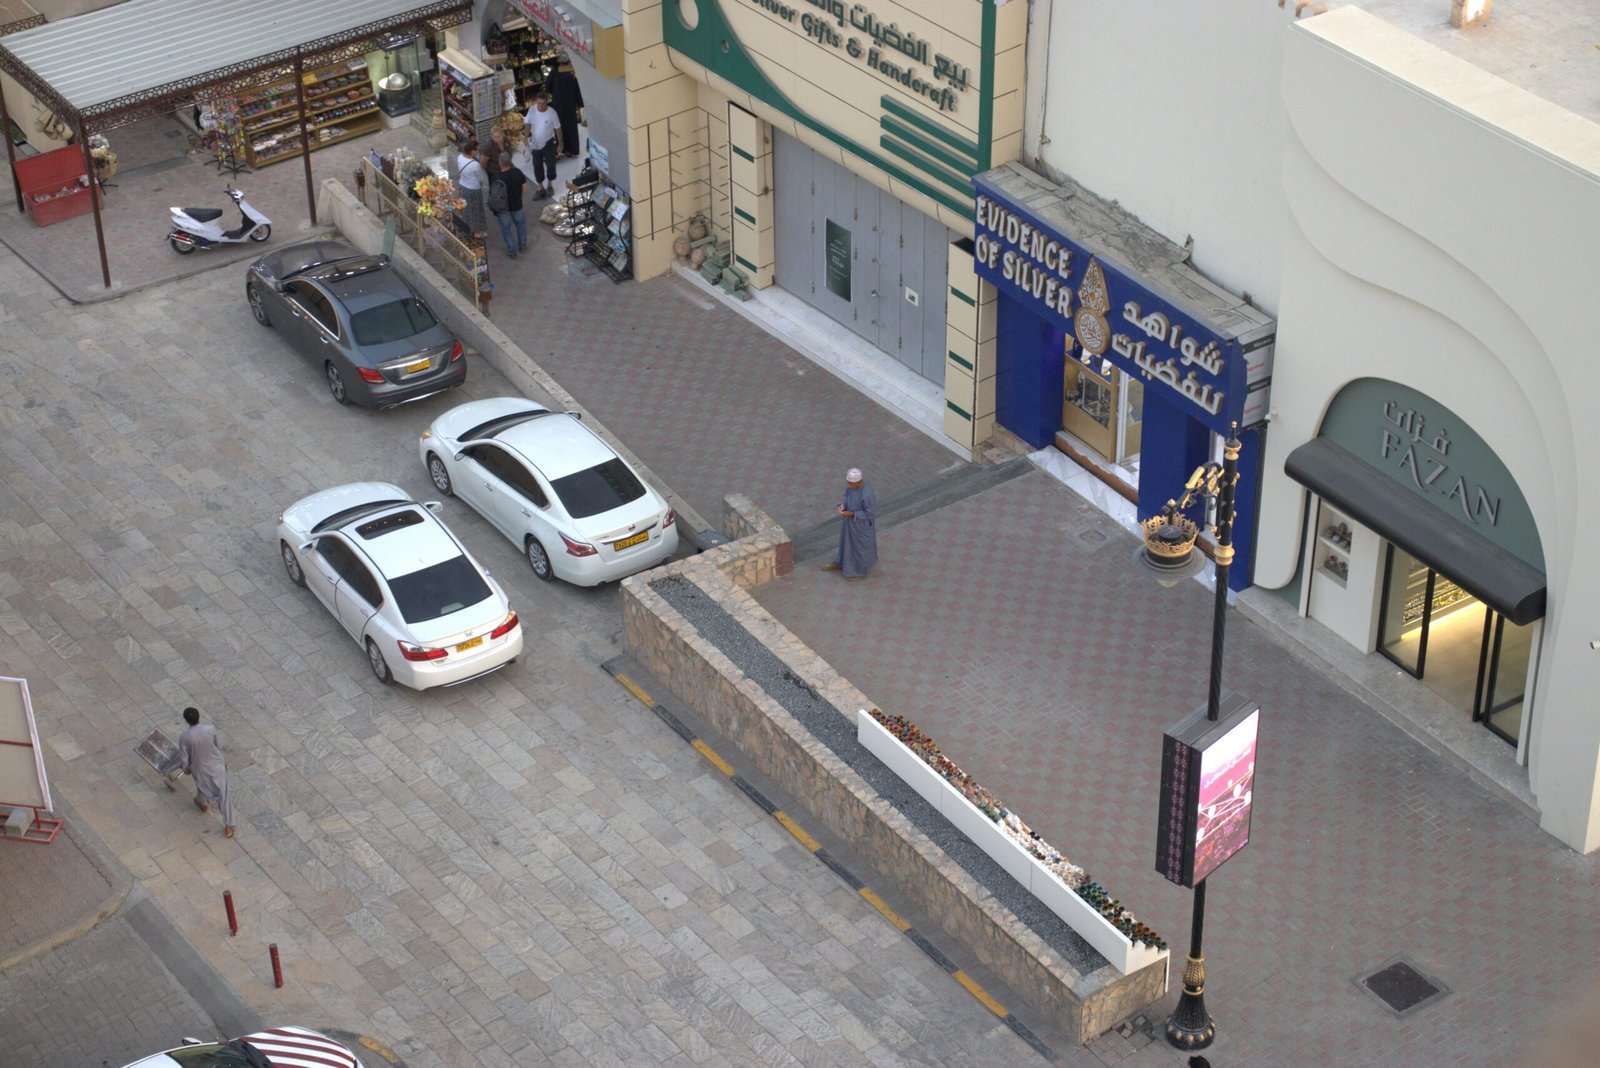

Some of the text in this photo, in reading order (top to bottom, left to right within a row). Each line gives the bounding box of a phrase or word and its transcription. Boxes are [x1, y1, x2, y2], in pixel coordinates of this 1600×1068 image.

[751, 0, 798, 22] ilver
[801, 12, 841, 48] Gifts
[846, 37, 864, 58] &
[850, 4, 929, 66] الفضيات
[933, 52, 969, 92] بيع
[976, 195, 1072, 279] EVIDENCE
[976, 234, 1073, 318] OF SILVER
[1112, 333, 1224, 416] للفضيات
[1123, 301, 1224, 377] شواهد
[1381, 429, 1501, 527] FAZAN
